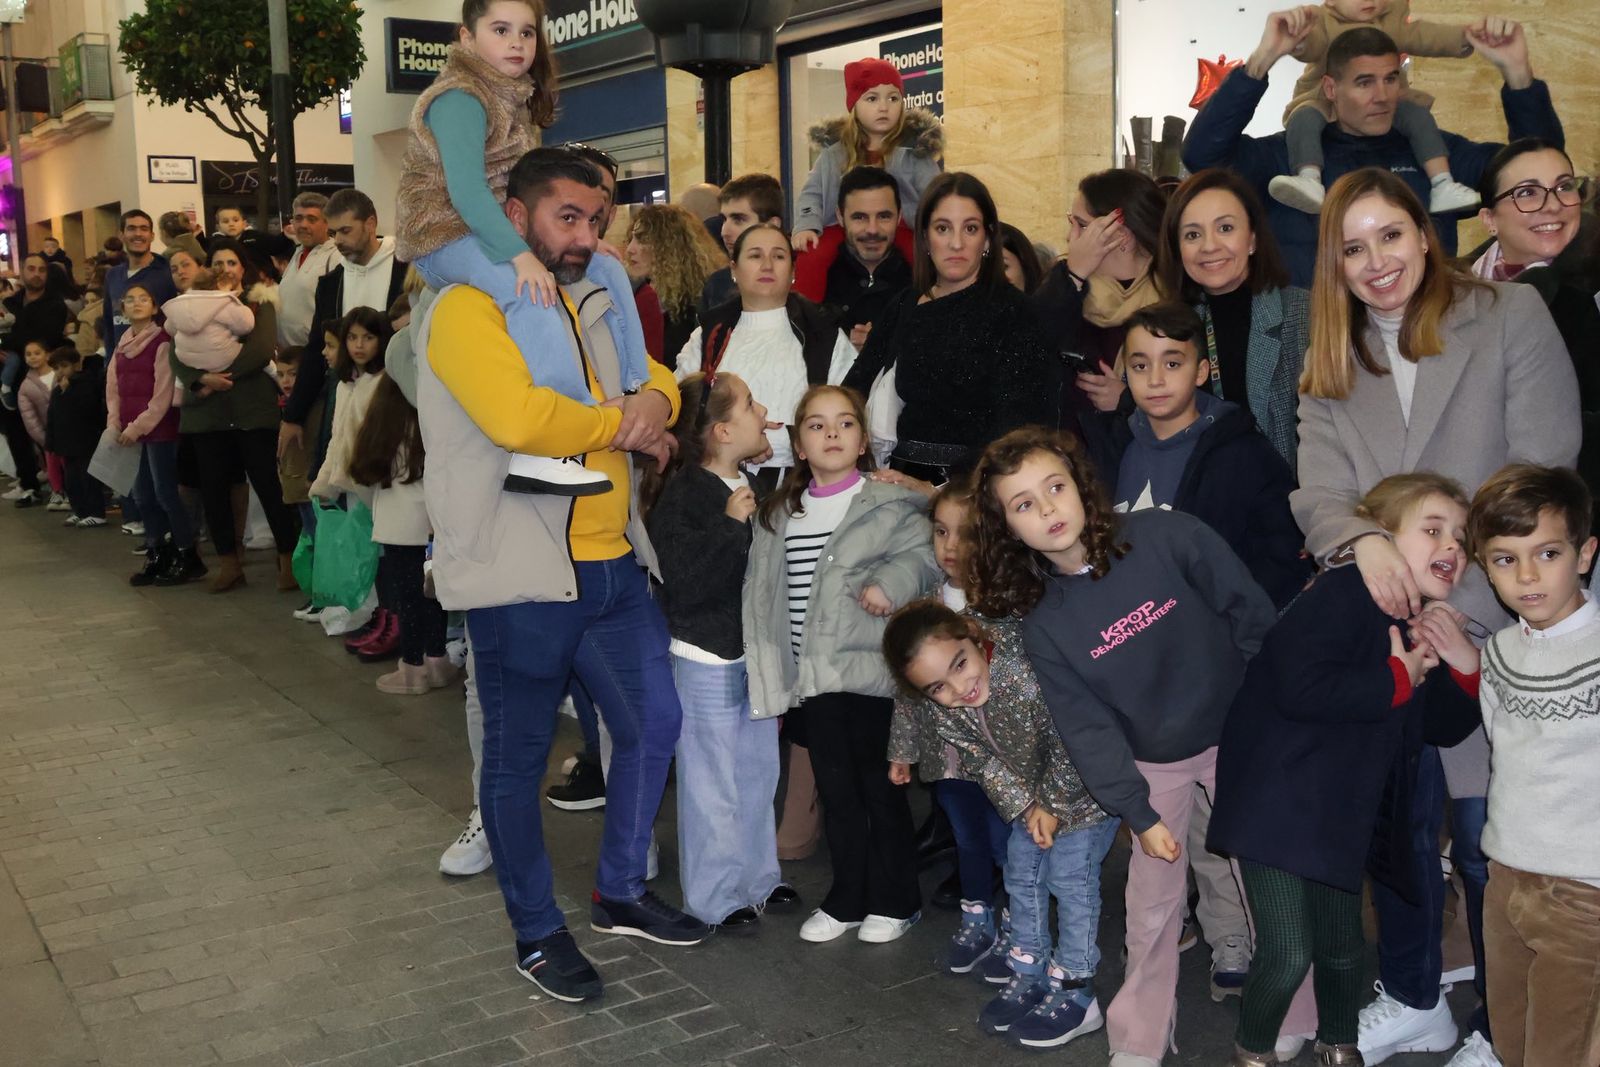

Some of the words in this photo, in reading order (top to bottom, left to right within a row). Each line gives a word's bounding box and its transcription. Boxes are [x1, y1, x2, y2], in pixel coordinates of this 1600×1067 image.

[542, 10, 589, 45] hone
[399, 54, 448, 71] Hous
[1090, 627, 1135, 659] DEMON
[1134, 598, 1177, 633] HUNTERS
[1100, 600, 1155, 642] KPOP
